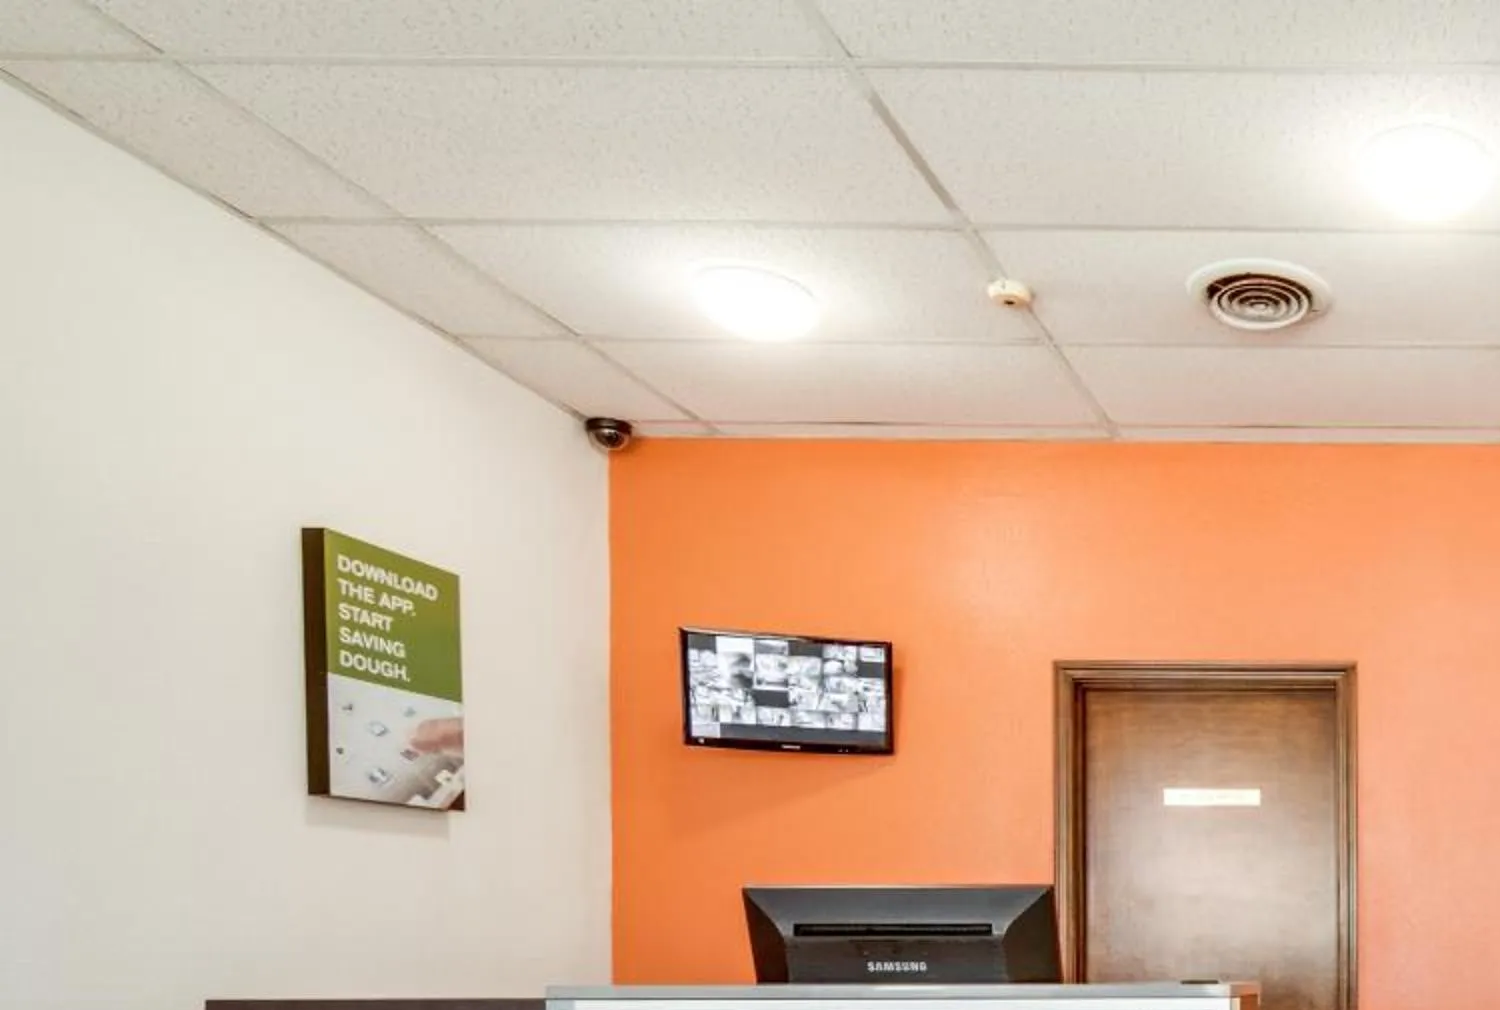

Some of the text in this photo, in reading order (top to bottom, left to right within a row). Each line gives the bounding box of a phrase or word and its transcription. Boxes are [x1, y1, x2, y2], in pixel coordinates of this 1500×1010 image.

[337, 553, 438, 601] DOWNLOAD
[337, 578, 416, 616] THE APP.
[338, 602, 394, 632] START
[338, 627, 406, 659] SAVING
[340, 651, 410, 682] DOUGH.
[866, 961, 928, 972] SAMSUNG
